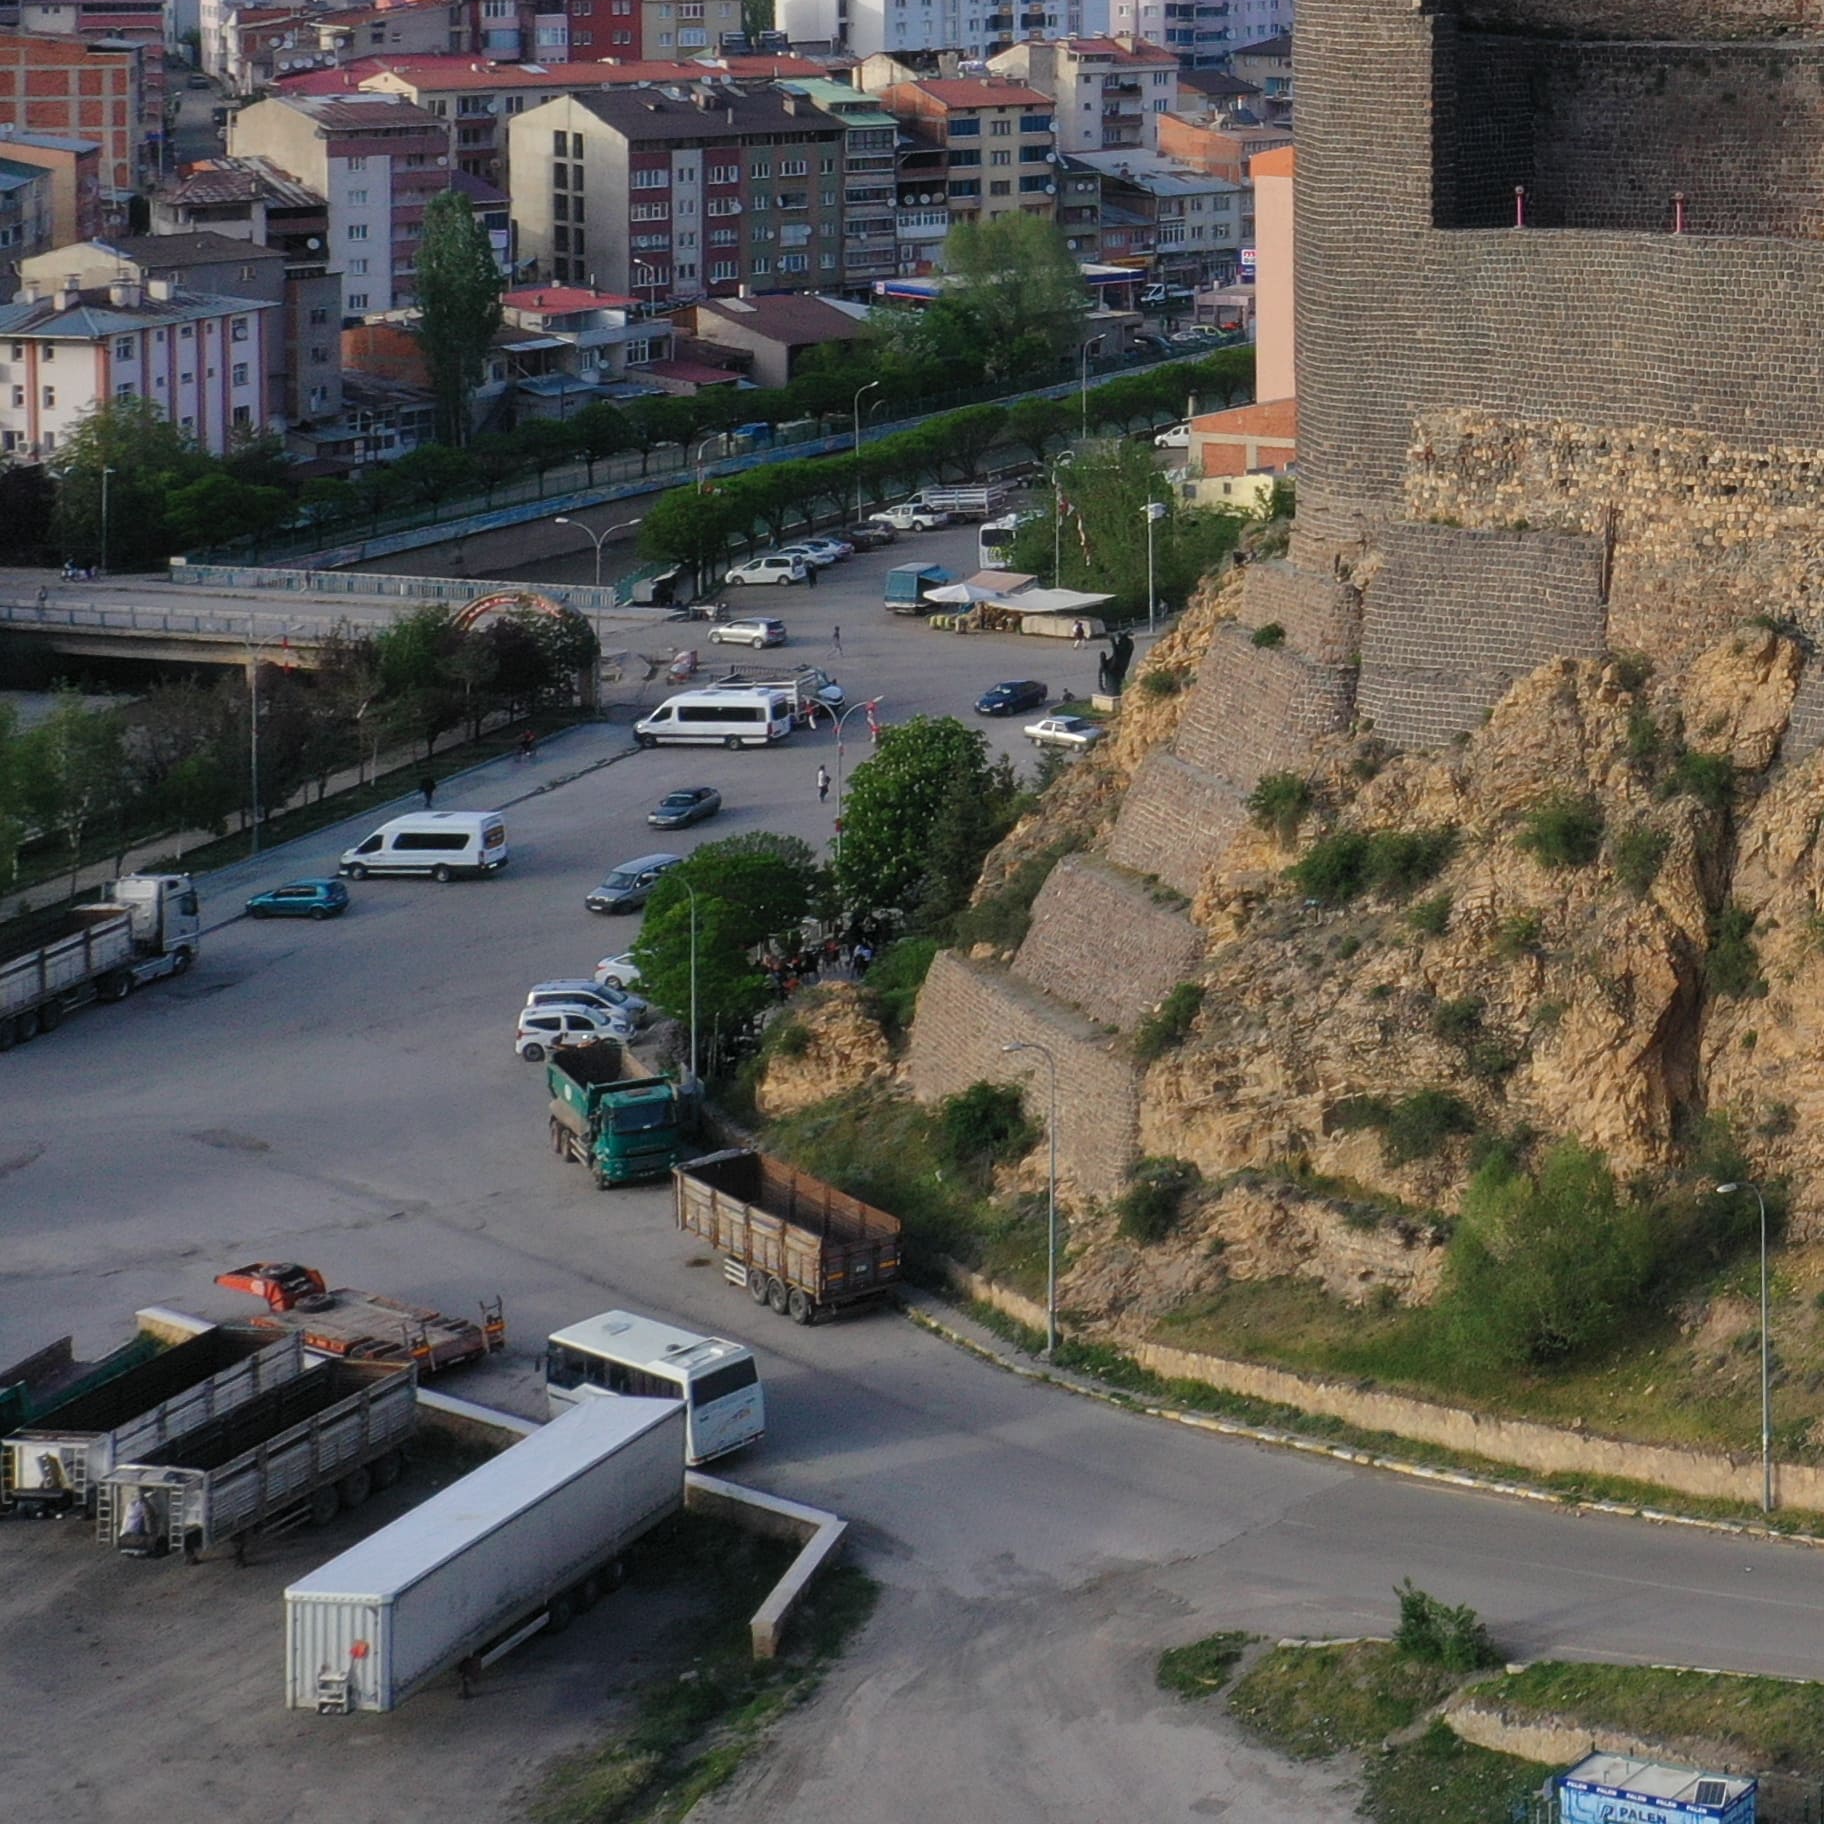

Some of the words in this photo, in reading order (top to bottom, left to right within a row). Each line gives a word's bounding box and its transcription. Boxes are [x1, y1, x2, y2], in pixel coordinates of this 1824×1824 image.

[1656, 1799, 1677, 1809] PALEN
[1686, 1805, 1707, 1815] PALEN
[1619, 1807, 1667, 1824] PALEN
